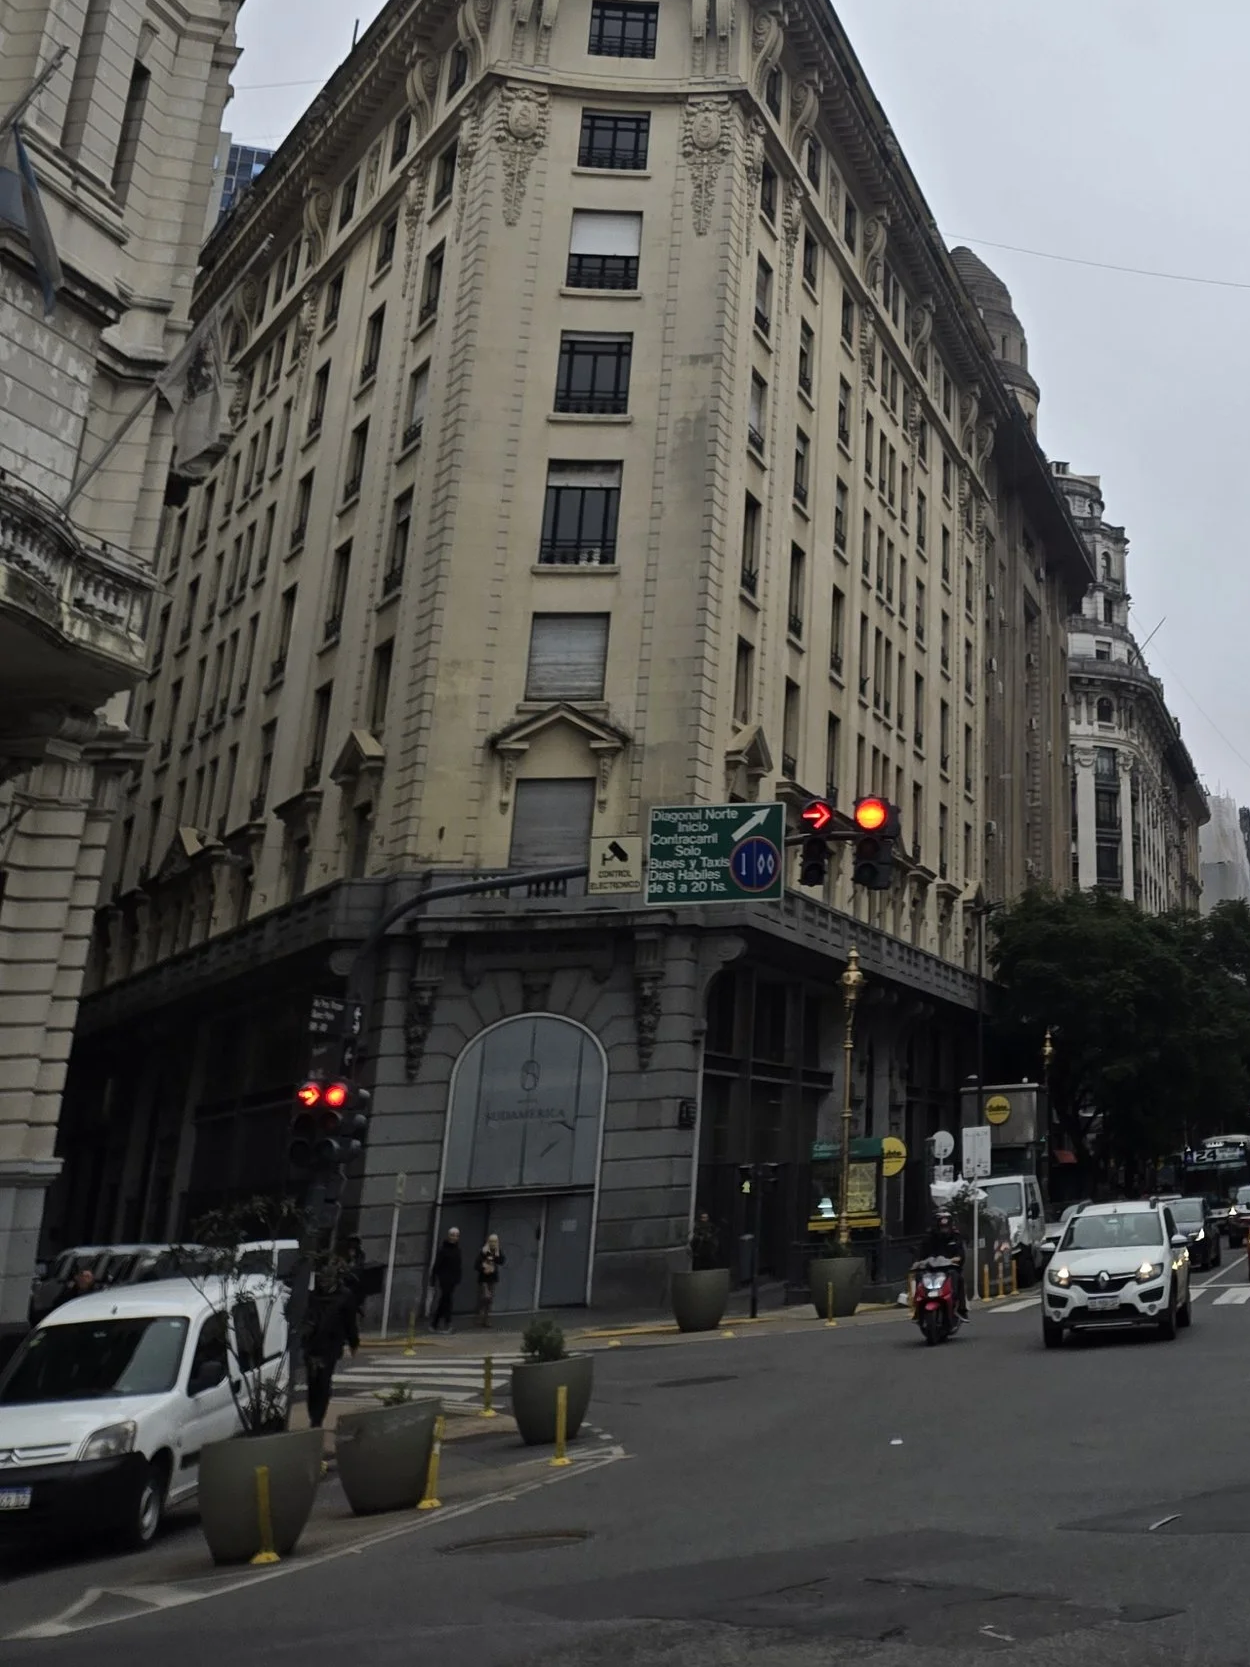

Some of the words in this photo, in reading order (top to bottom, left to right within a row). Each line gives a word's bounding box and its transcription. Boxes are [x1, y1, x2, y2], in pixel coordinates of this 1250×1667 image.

[652, 809, 702, 823] Diagonal
[705, 808, 739, 820] Norte
[677, 822, 709, 832] Inicio
[651, 833, 718, 845] Contracarril
[675, 845, 702, 857] Solo
[650, 857, 686, 870] Buses
[690, 859, 698, 871] y
[701, 856, 730, 867] Taxis
[598, 870, 632, 878] CONTROL
[648, 882, 663, 894] de
[666, 881, 677, 893] 8
[679, 883, 688, 893] a
[691, 881, 708, 892] 20
[1195, 1149, 1217, 1162] 24
